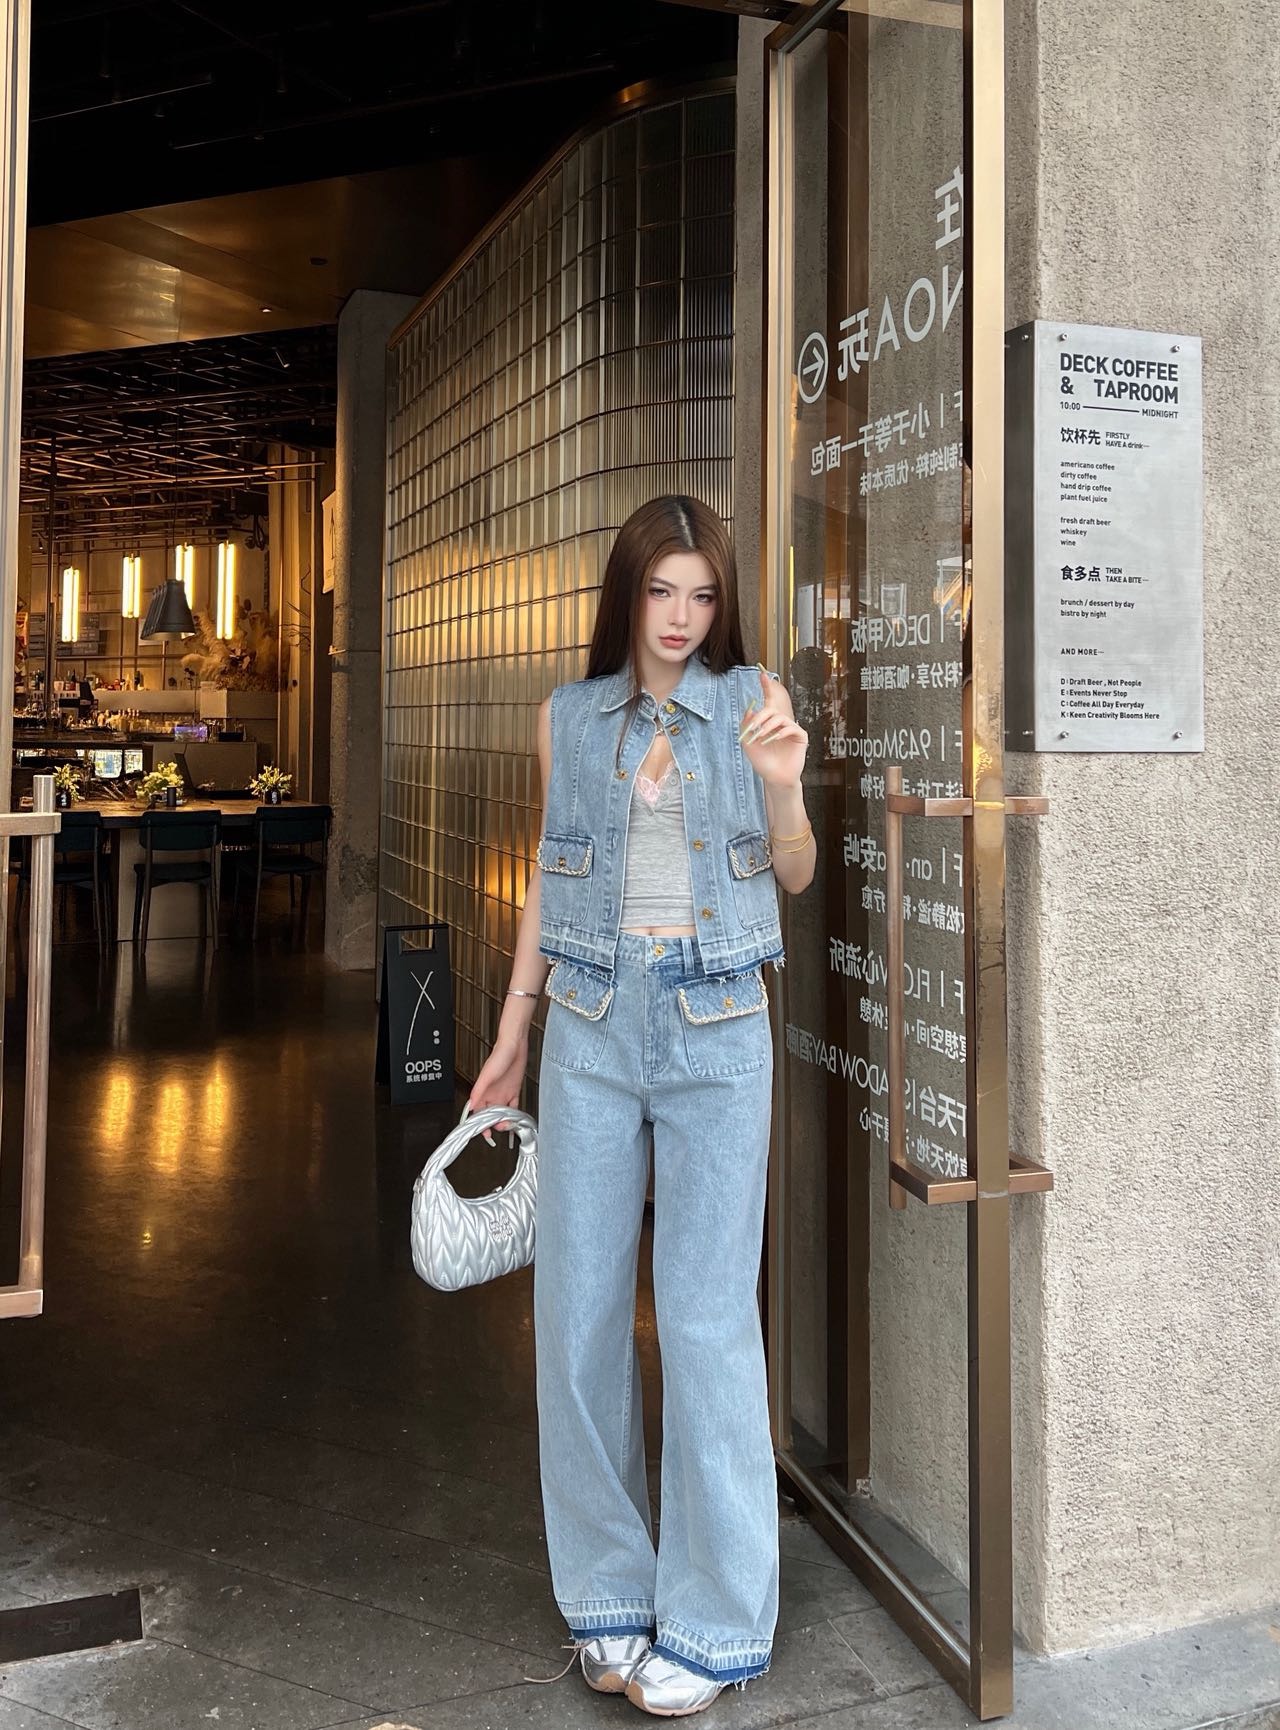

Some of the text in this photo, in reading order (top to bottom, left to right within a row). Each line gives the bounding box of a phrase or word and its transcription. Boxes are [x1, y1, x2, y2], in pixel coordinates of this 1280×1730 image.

[1060, 353, 1178, 381] DECK COFFEE
[1060, 376, 1178, 404] & TAPROOM
[1060, 401, 1178, 419] 10:00 MIDNIGHT
[1060, 427, 1101, 445] 饮杯先
[1105, 432, 1130, 440] FIRSTLY
[1105, 440, 1121, 448] HAVE
[1060, 461, 1094, 469] americano
[1060, 471, 1097, 480] dirty coffee
[1060, 482, 1112, 492] hand drip coffee
[1060, 493, 1108, 503] plant fuel juice
[1060, 516, 1112, 526] fresh draft beer
[1060, 528, 1087, 537] whiskey
[1060, 565, 1101, 582] 食多点
[1105, 567, 1122, 575] THEN
[1105, 575, 1121, 583] TAKE
[1060, 598, 1083, 607] brunch
[1089, 599, 1114, 607] dessert
[1114, 600, 1122, 609] by
[1123, 601, 1135, 609] day
[1060, 609, 1107, 619] bistro by night
[1107, 679, 1119, 687] Not
[1120, 679, 1142, 688] People
[1113, 690, 1128, 698] Stop
[1102, 701, 1115, 710] Day
[1115, 701, 1145, 710] Everyday
[1087, 712, 1119, 720] Creativity
[1119, 712, 1144, 720] Blooms
[1144, 712, 1160, 720] Here
[405, 1059, 441, 1074] OOPS
